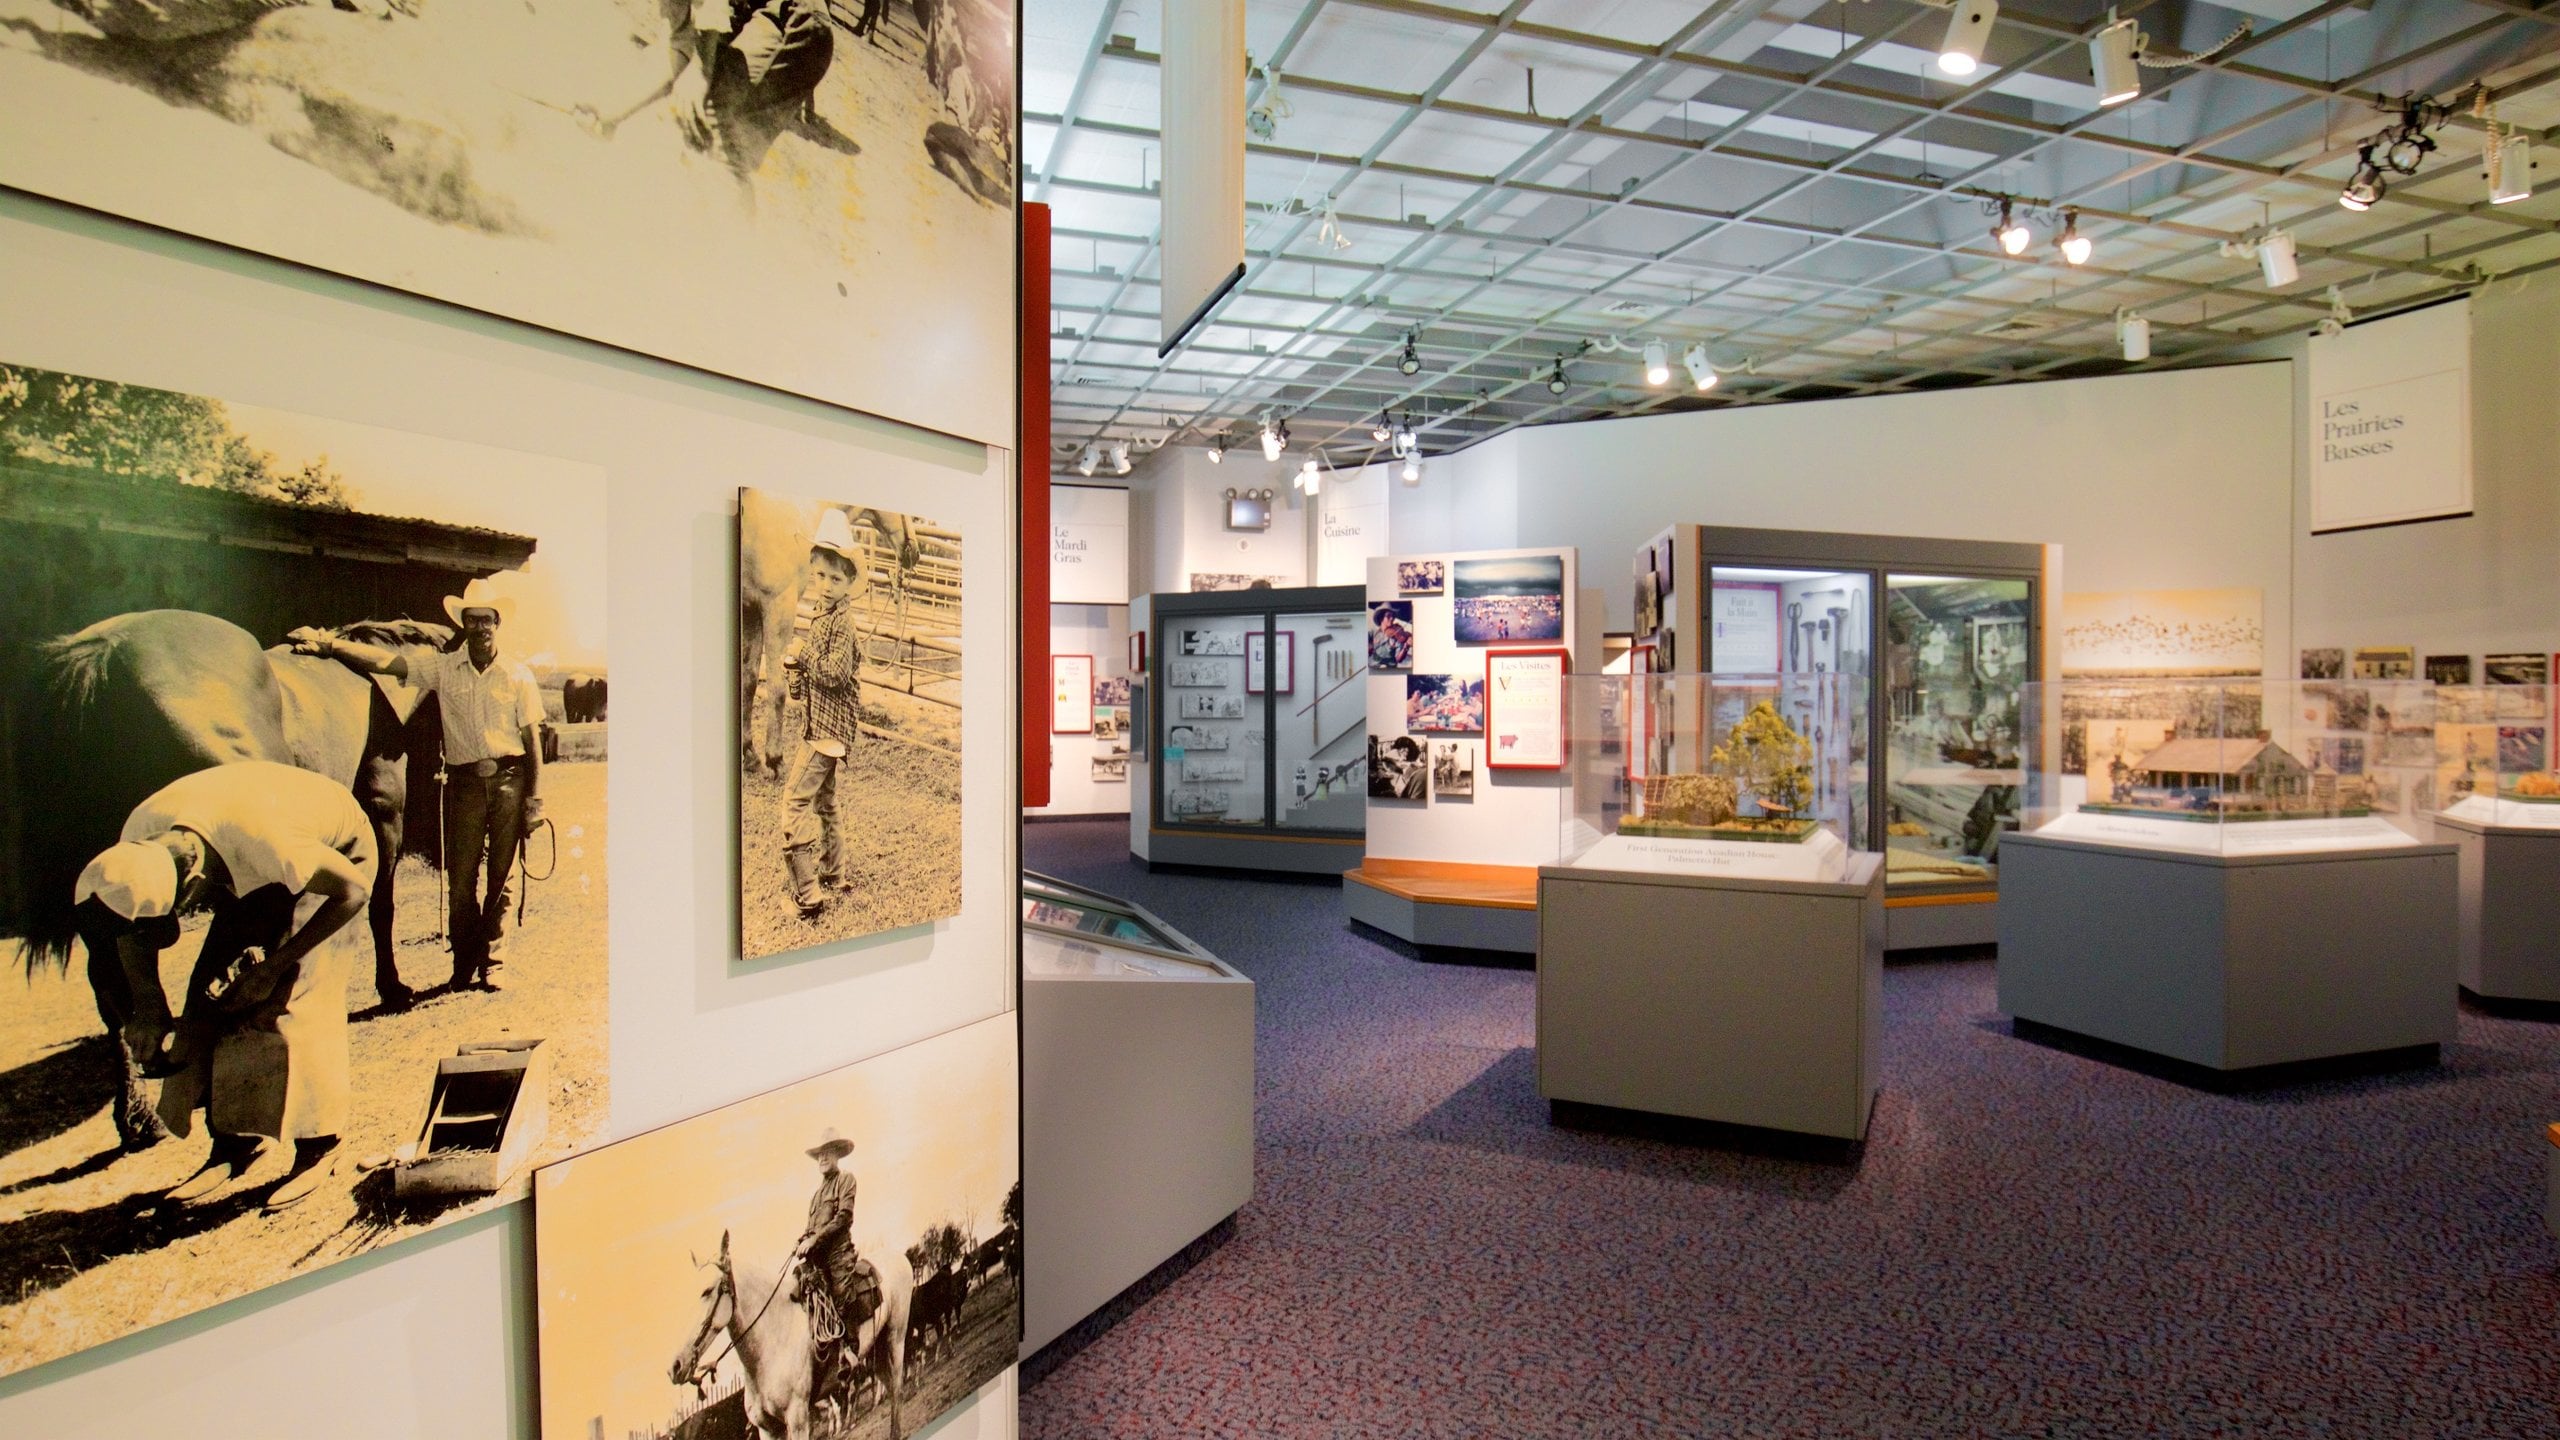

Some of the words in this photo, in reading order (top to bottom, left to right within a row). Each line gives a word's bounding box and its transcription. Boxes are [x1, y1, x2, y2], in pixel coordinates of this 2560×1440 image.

[2323, 401, 2360, 419] Les
[2323, 415, 2405, 440] Prairies
[2323, 439, 2395, 462] Basses
[1324, 512, 1337, 525] La
[1054, 525, 1069, 538] Le
[1324, 525, 1361, 538] Cuisine
[1054, 538, 1087, 551] Mardi
[1054, 551, 1082, 564] Gras
[1519, 660, 1552, 670] Visites
[1650, 845, 1704, 855] Generation
